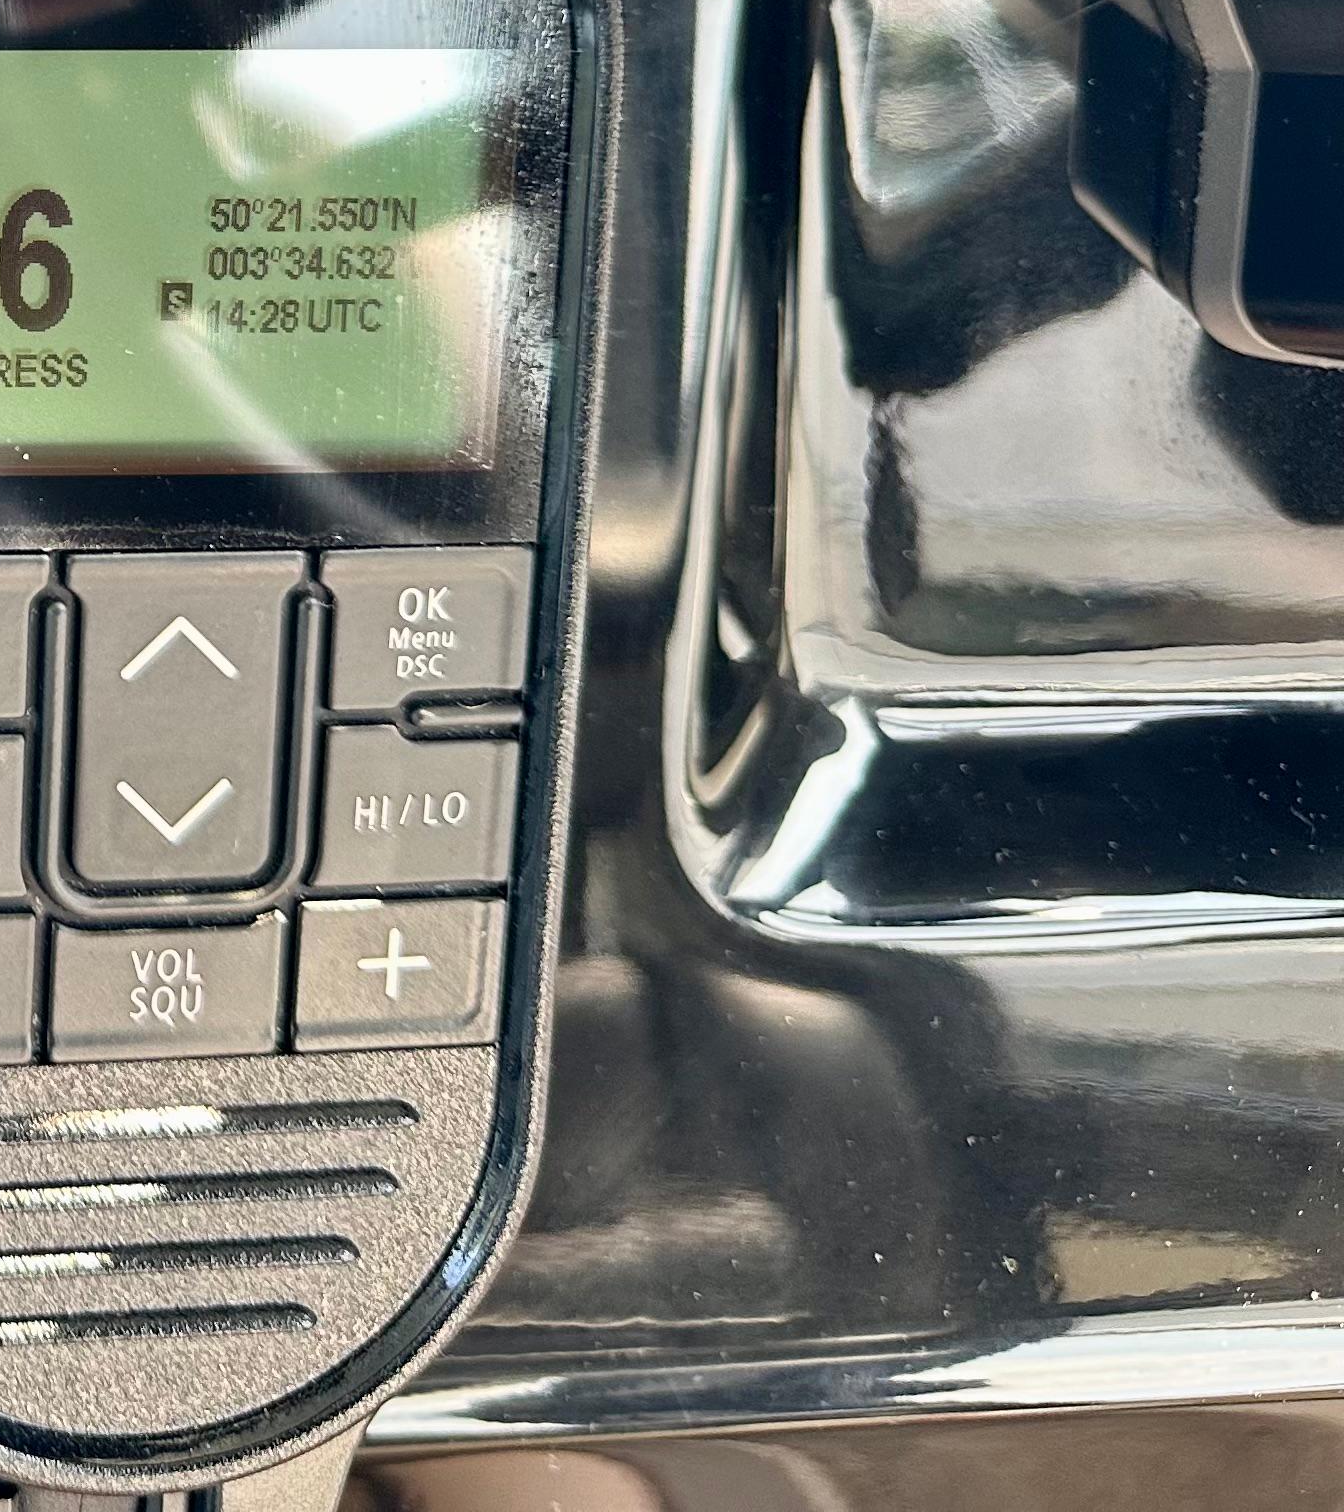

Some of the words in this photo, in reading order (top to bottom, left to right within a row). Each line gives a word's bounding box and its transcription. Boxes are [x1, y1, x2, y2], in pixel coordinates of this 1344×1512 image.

[209, 246, 422, 280] 003°34.632
[209, 299, 299, 333] 14:28
[308, 299, 382, 333] UTC
[397, 587, 452, 622] OK
[388, 627, 455, 653] Menu
[395, 654, 445, 679] DSC
[130, 948, 202, 984] VOL
[129, 985, 202, 1026] SQU
